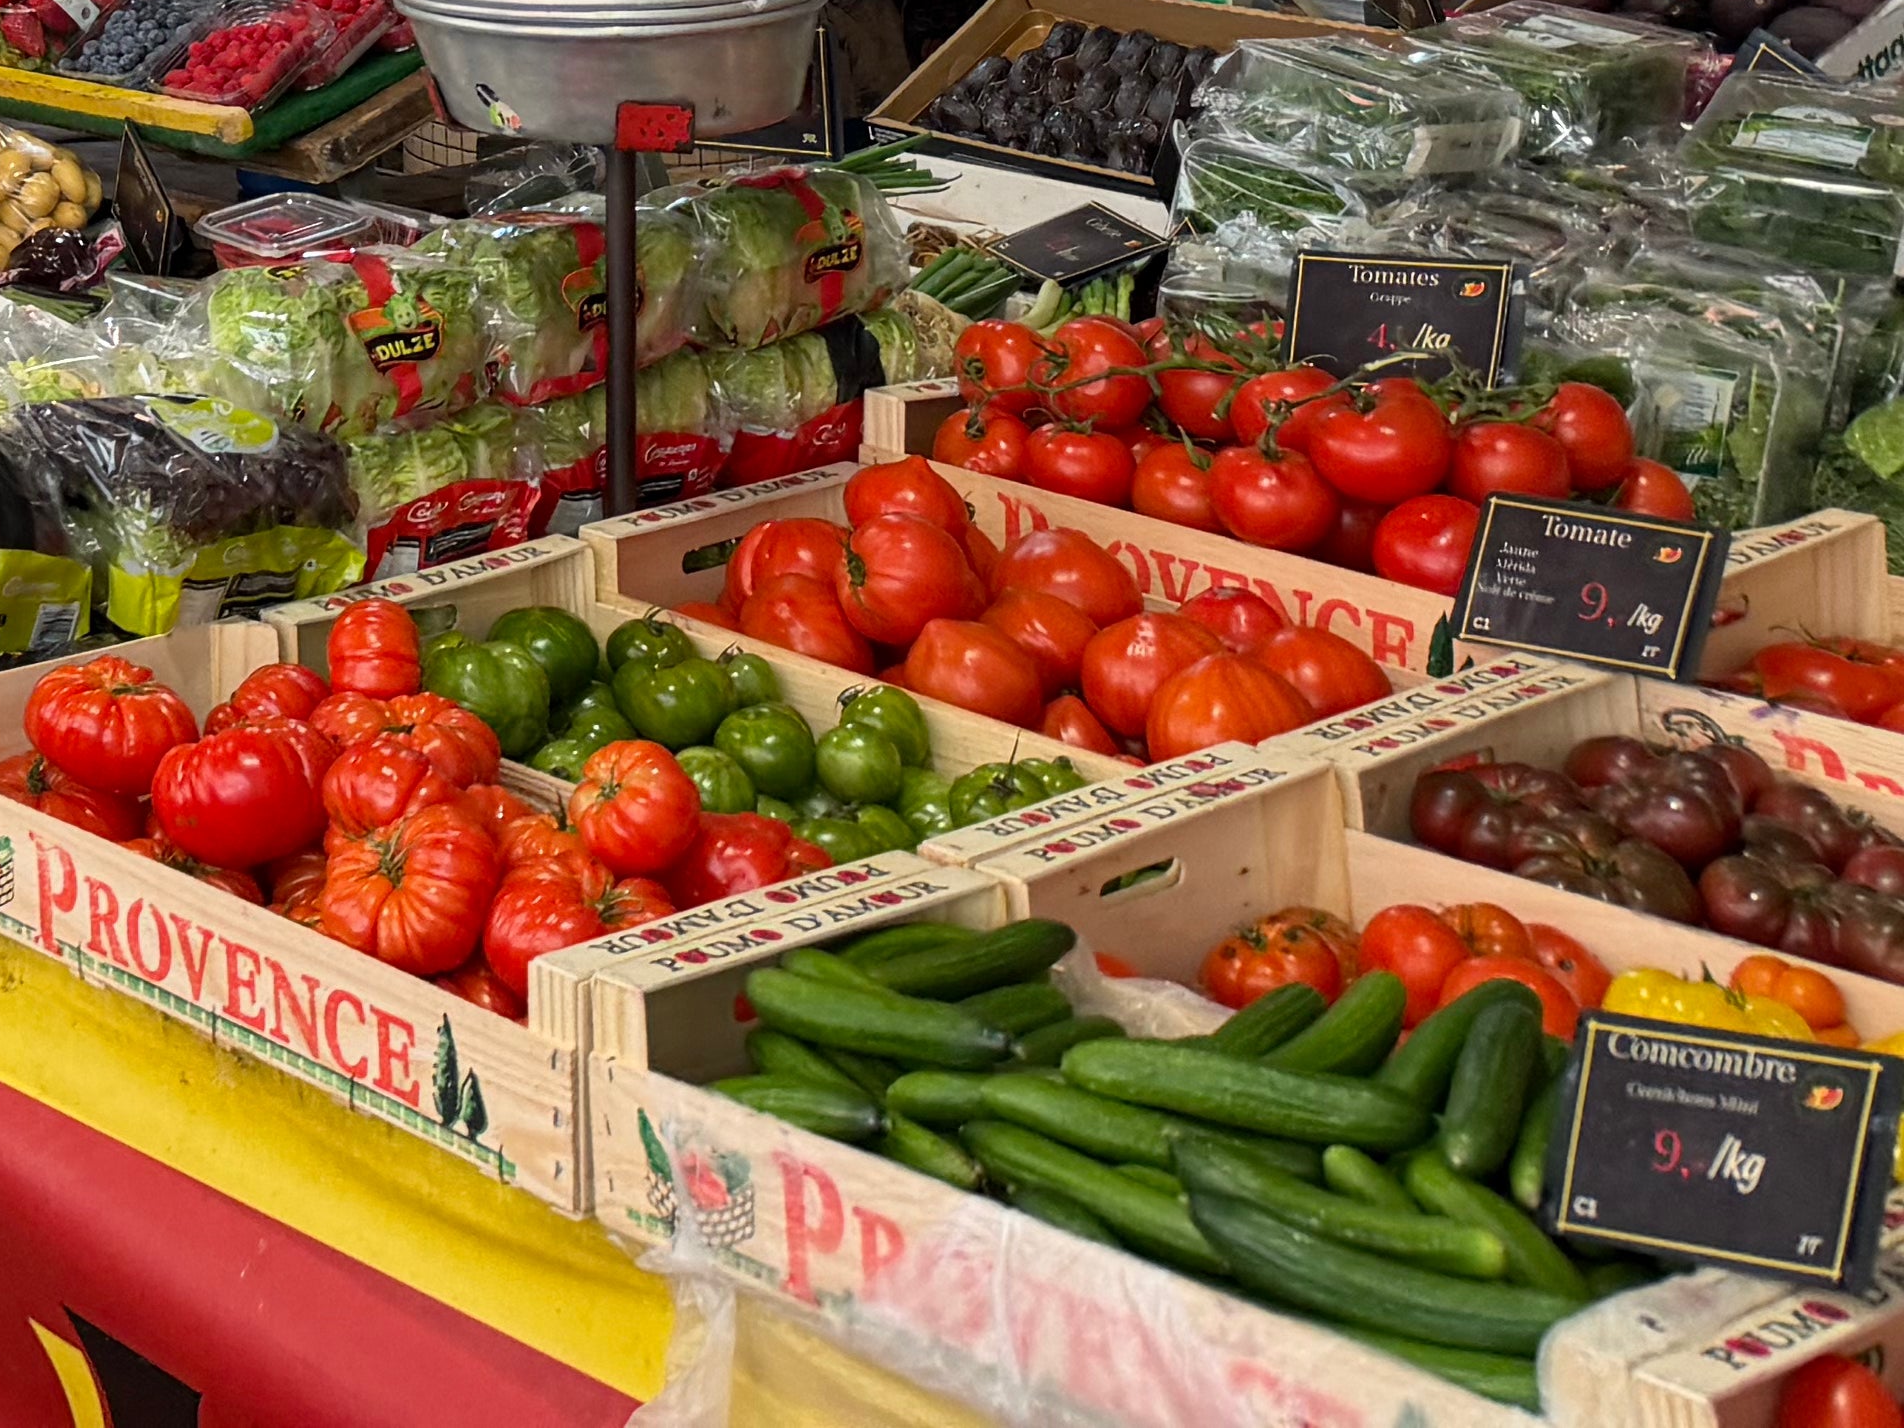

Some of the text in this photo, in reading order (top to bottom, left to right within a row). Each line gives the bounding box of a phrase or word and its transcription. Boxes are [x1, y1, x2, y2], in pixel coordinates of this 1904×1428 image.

[1348, 264, 1440, 288] Tomates
[376, 333, 435, 361] DULZE
[1541, 514, 1632, 549] Tomate
[1627, 602, 1664, 635] /kg
[28, 828, 422, 1109] PROVENCE
[1706, 1133, 1766, 1195] /kg
